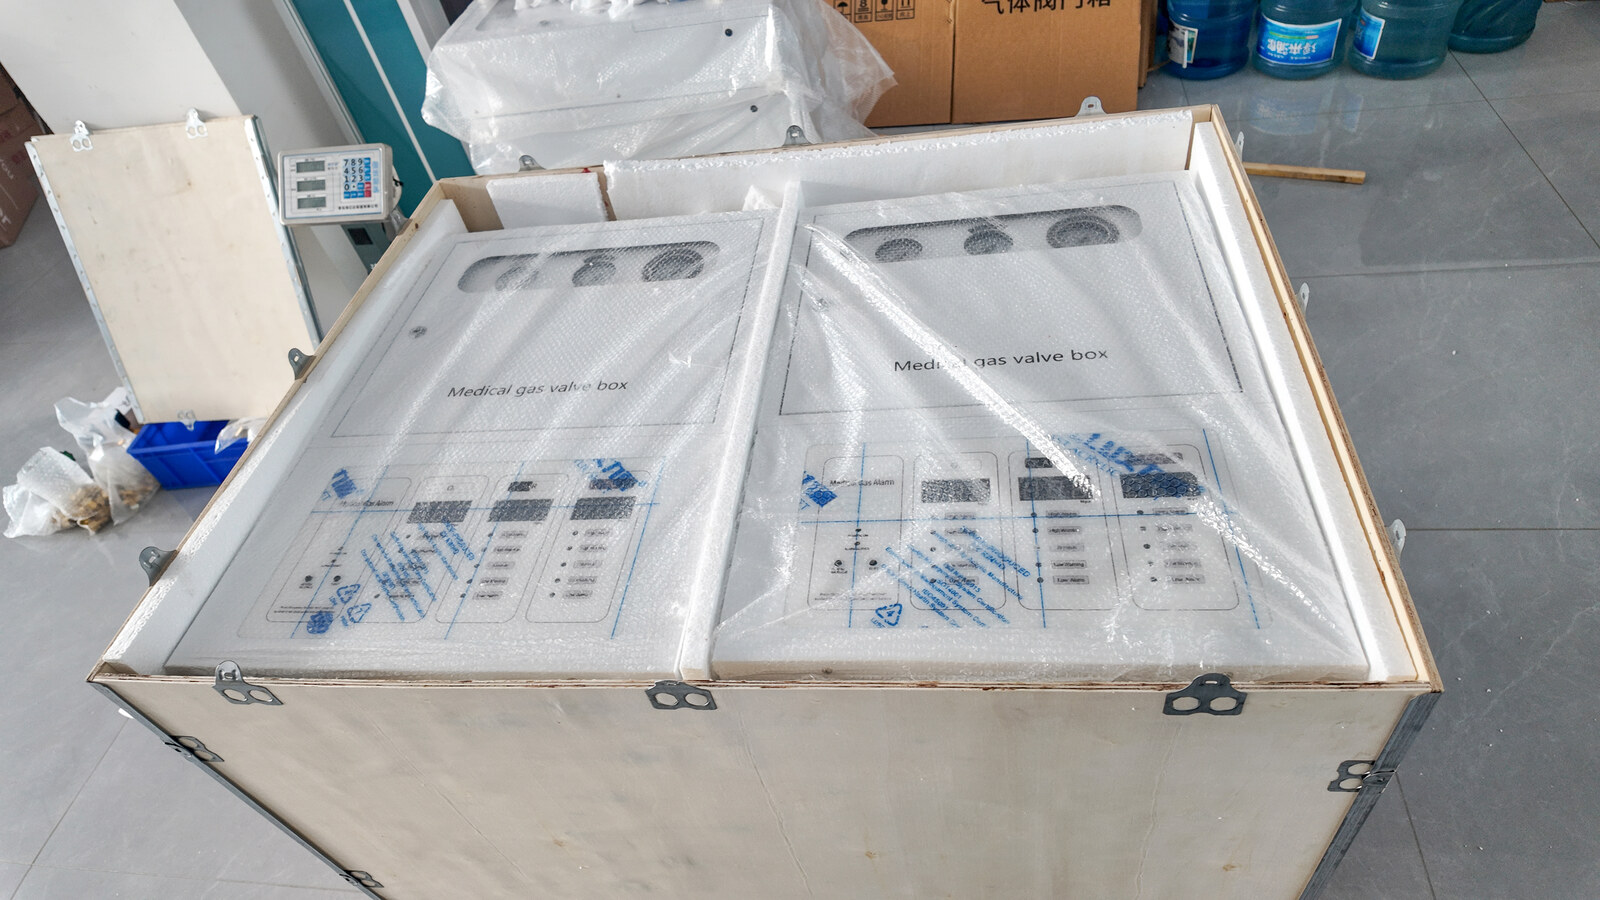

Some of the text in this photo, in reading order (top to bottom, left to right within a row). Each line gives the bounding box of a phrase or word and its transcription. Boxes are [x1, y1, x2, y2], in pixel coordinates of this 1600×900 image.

[894, 349, 1108, 371] Medil gas valve box
[448, 385, 512, 398] Medical
[515, 384, 545, 397] gas
[597, 380, 629, 391] box
